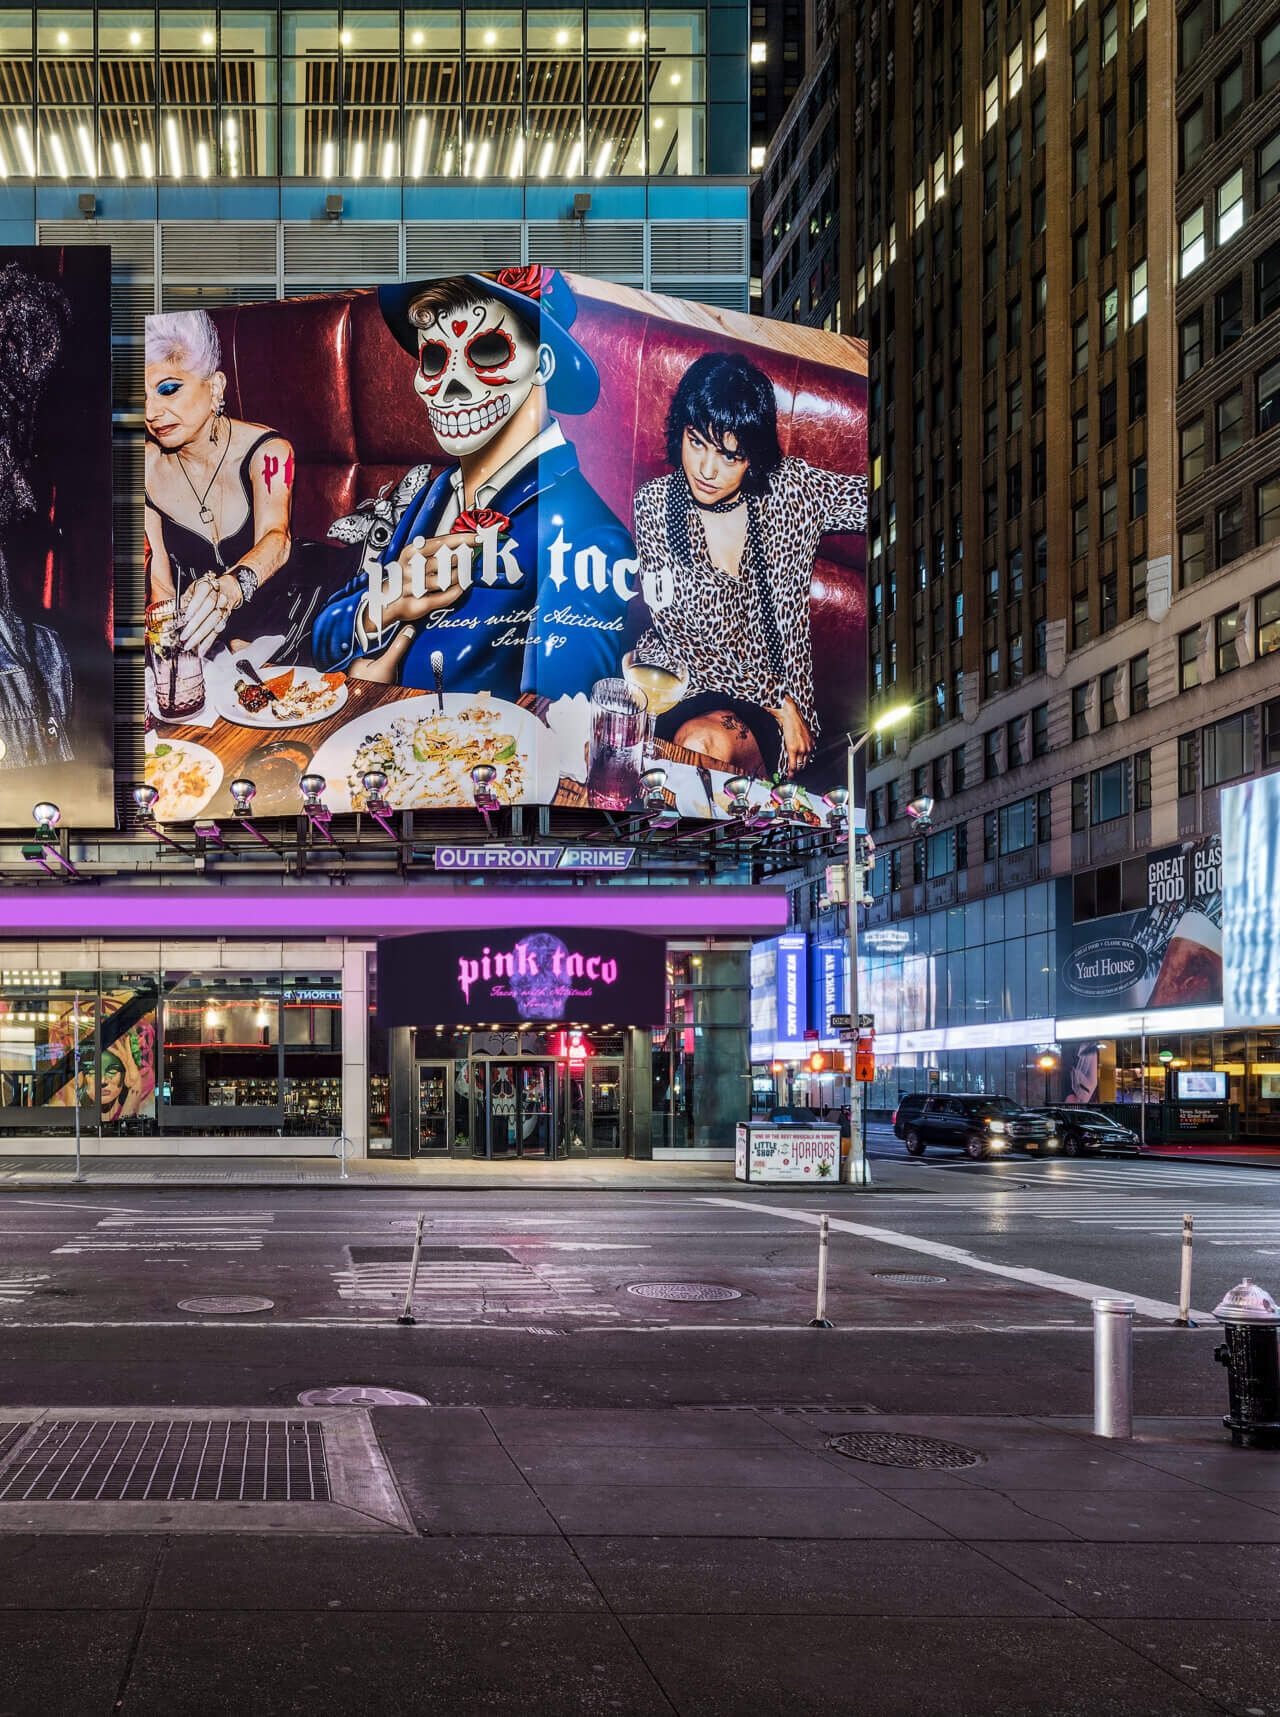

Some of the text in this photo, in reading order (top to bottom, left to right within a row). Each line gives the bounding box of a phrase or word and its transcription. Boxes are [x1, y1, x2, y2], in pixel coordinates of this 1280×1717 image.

[361, 522, 675, 648] pink taco
[425, 605, 624, 631] Tacos with Attitude
[491, 627, 541, 648] Since
[440, 850, 626, 866] OUTFRONT PRIME
[1148, 855, 1185, 883] GREAT
[1148, 877, 1185, 905] FOOD
[457, 943, 618, 1006] pink taco
[1075, 958, 1135, 979] Yard House
[754, 1141, 777, 1150] LITTLE
[756, 1149, 775, 1157] SHOP
[791, 1141, 835, 1163] HORRORS
